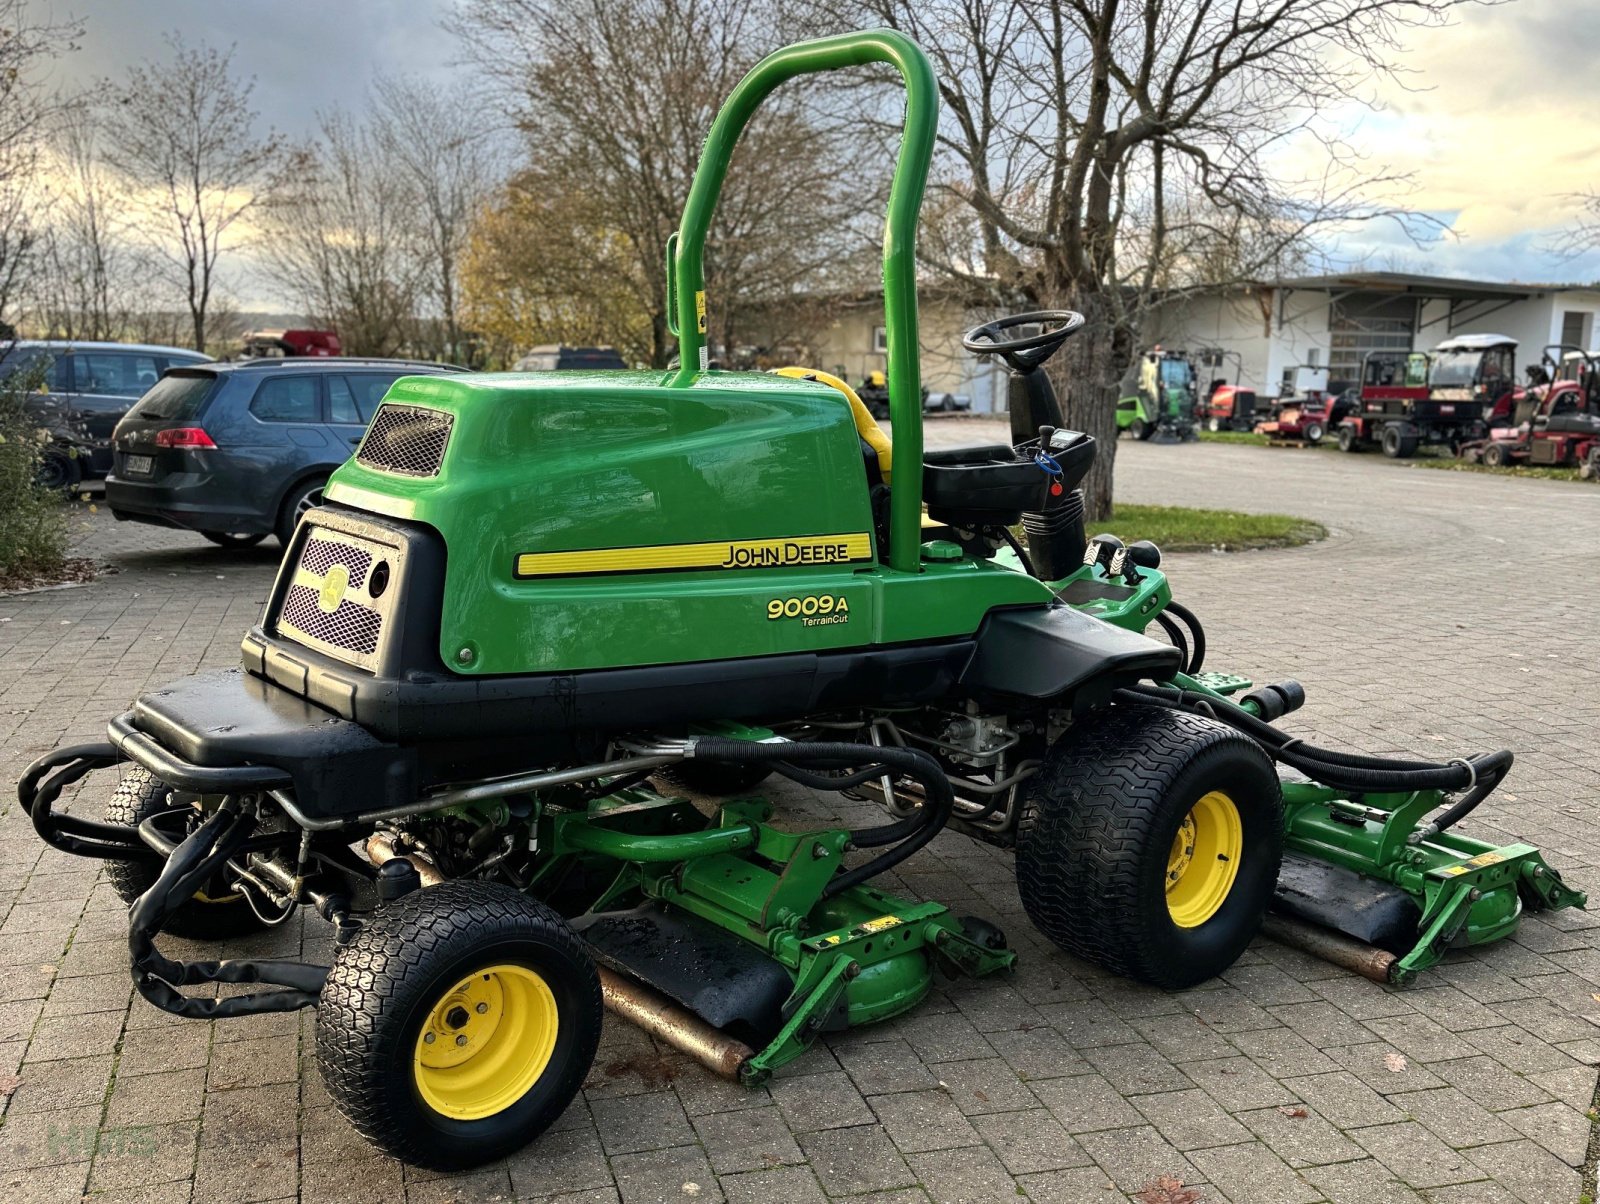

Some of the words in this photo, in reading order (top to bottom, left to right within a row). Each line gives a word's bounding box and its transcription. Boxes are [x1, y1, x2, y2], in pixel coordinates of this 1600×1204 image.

[723, 545, 780, 567] JOHN
[785, 542, 849, 564] DEERE
[801, 614, 848, 627] TerrainCut
